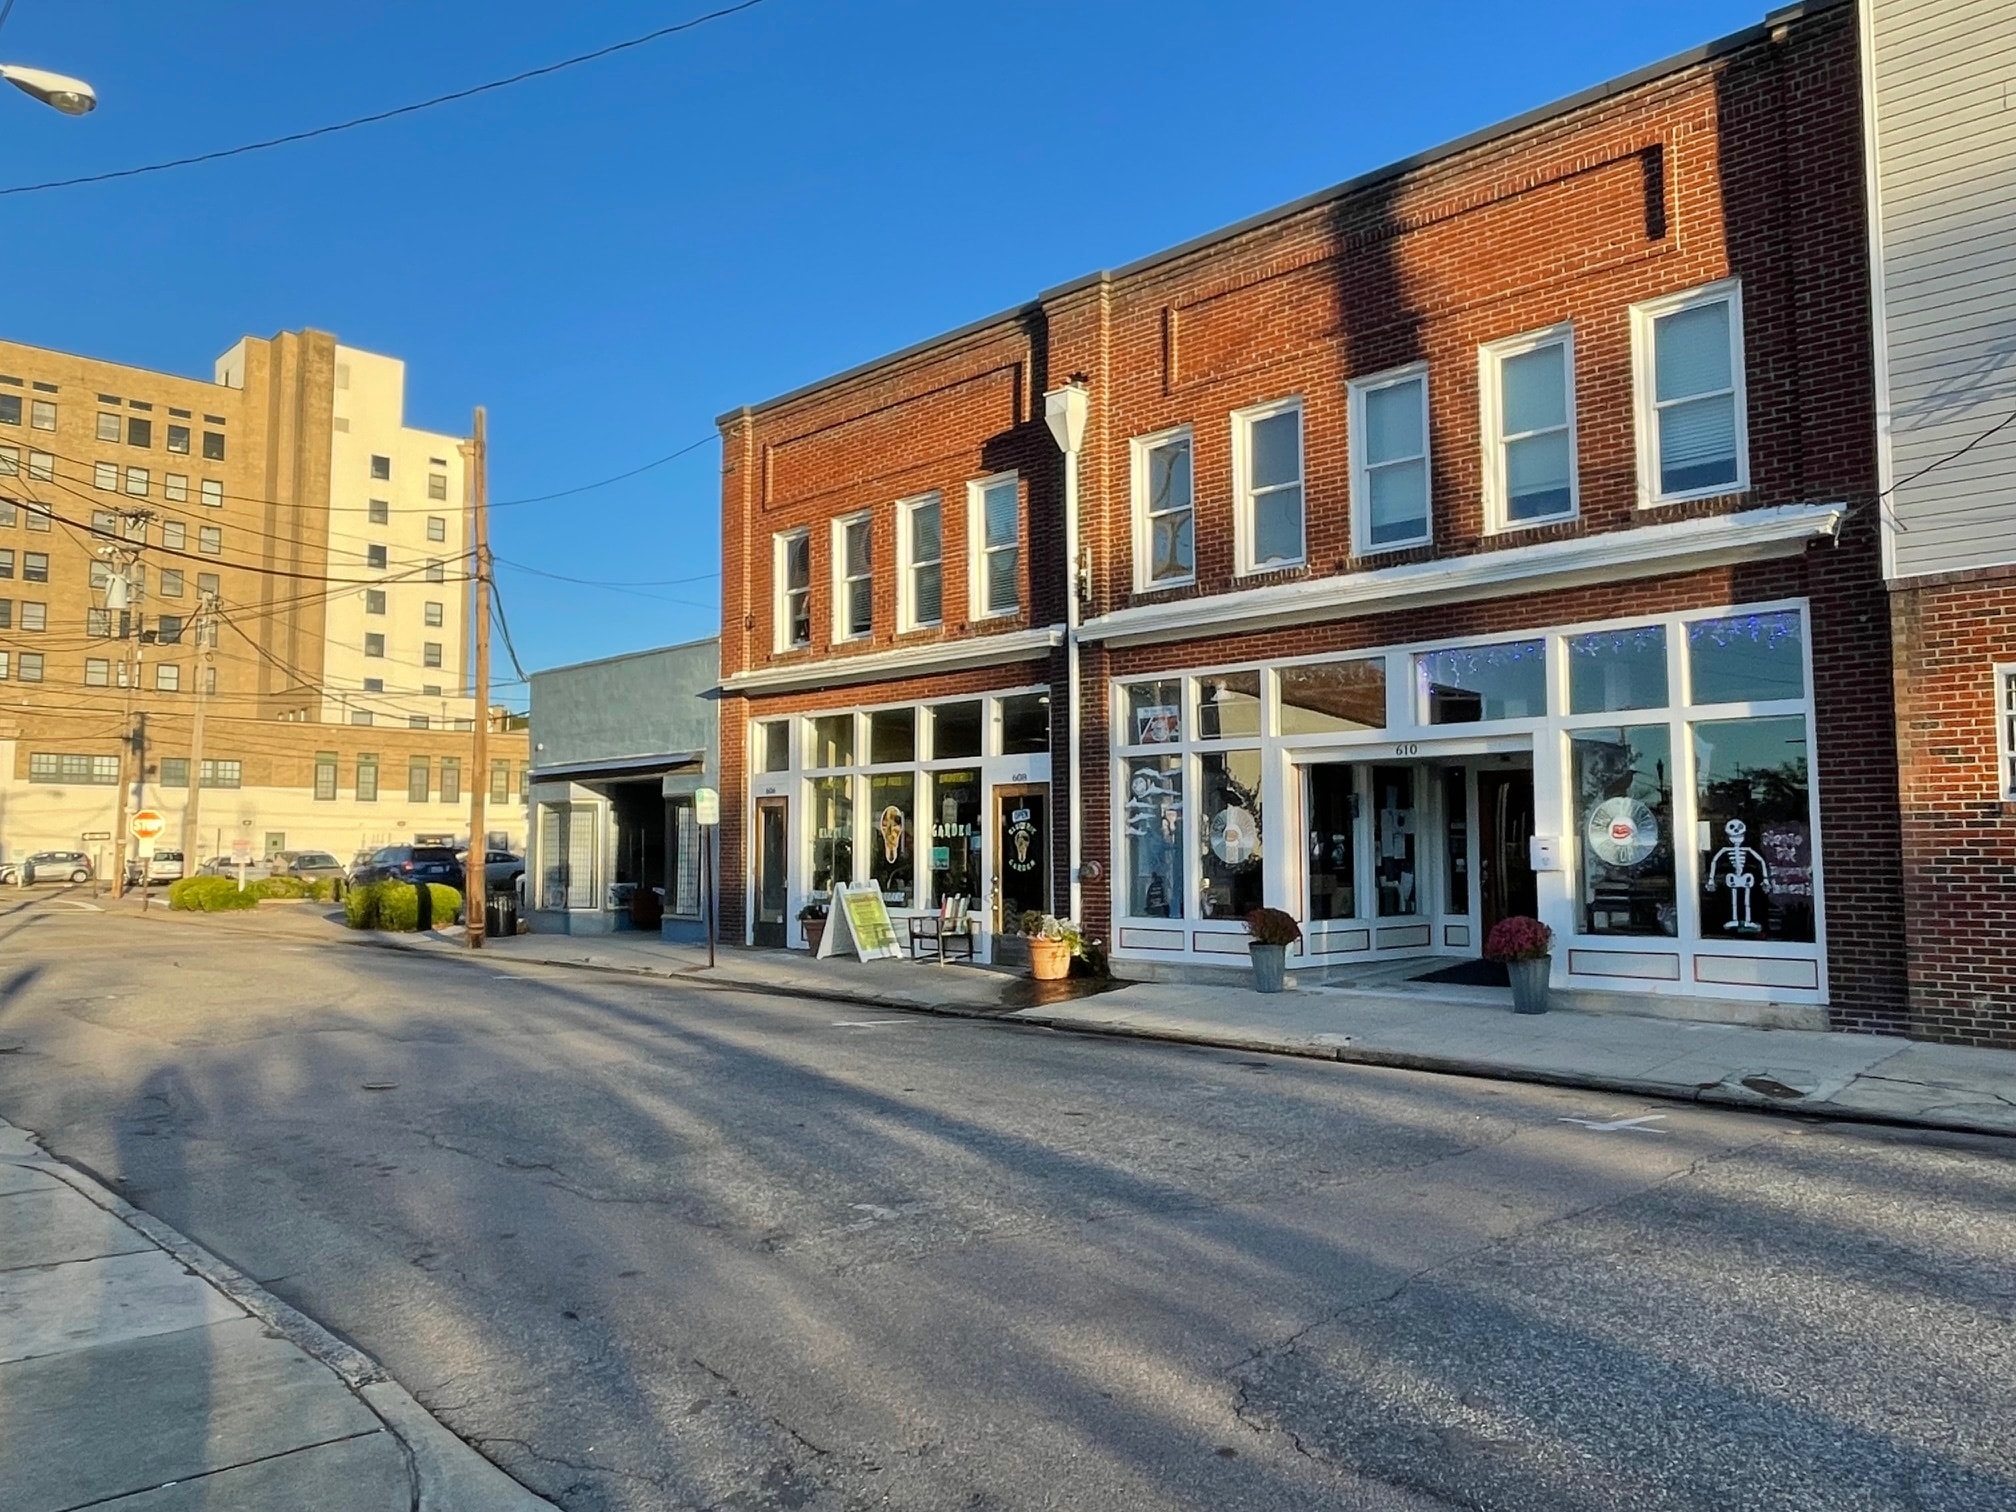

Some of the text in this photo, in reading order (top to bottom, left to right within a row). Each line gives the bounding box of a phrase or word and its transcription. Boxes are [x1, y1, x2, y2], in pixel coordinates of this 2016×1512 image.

[1395, 743, 1418, 756] 610
[133, 818, 163, 832] STOP
[931, 822, 972, 838] GARDEN
